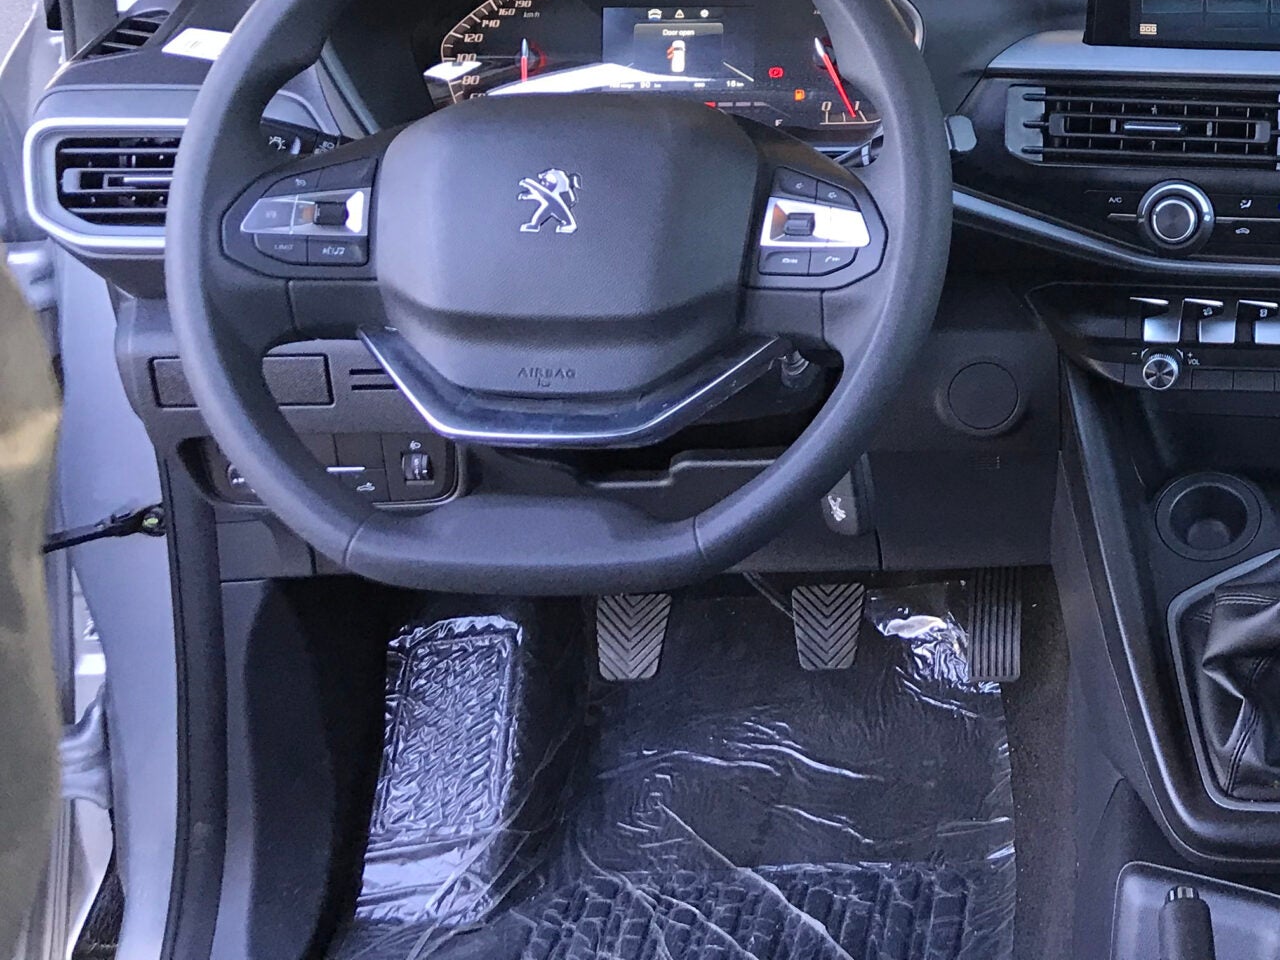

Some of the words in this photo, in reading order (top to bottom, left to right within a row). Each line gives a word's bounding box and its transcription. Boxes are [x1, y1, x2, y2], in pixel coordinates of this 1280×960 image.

[515, 0, 532, 8] 190
[498, 8, 516, 16] 160
[482, 19, 500, 28] 140
[464, 33, 484, 43] 120
[456, 53, 477, 62] 100
[462, 75, 480, 85] 80
[518, 367, 576, 379] AIRBAG
